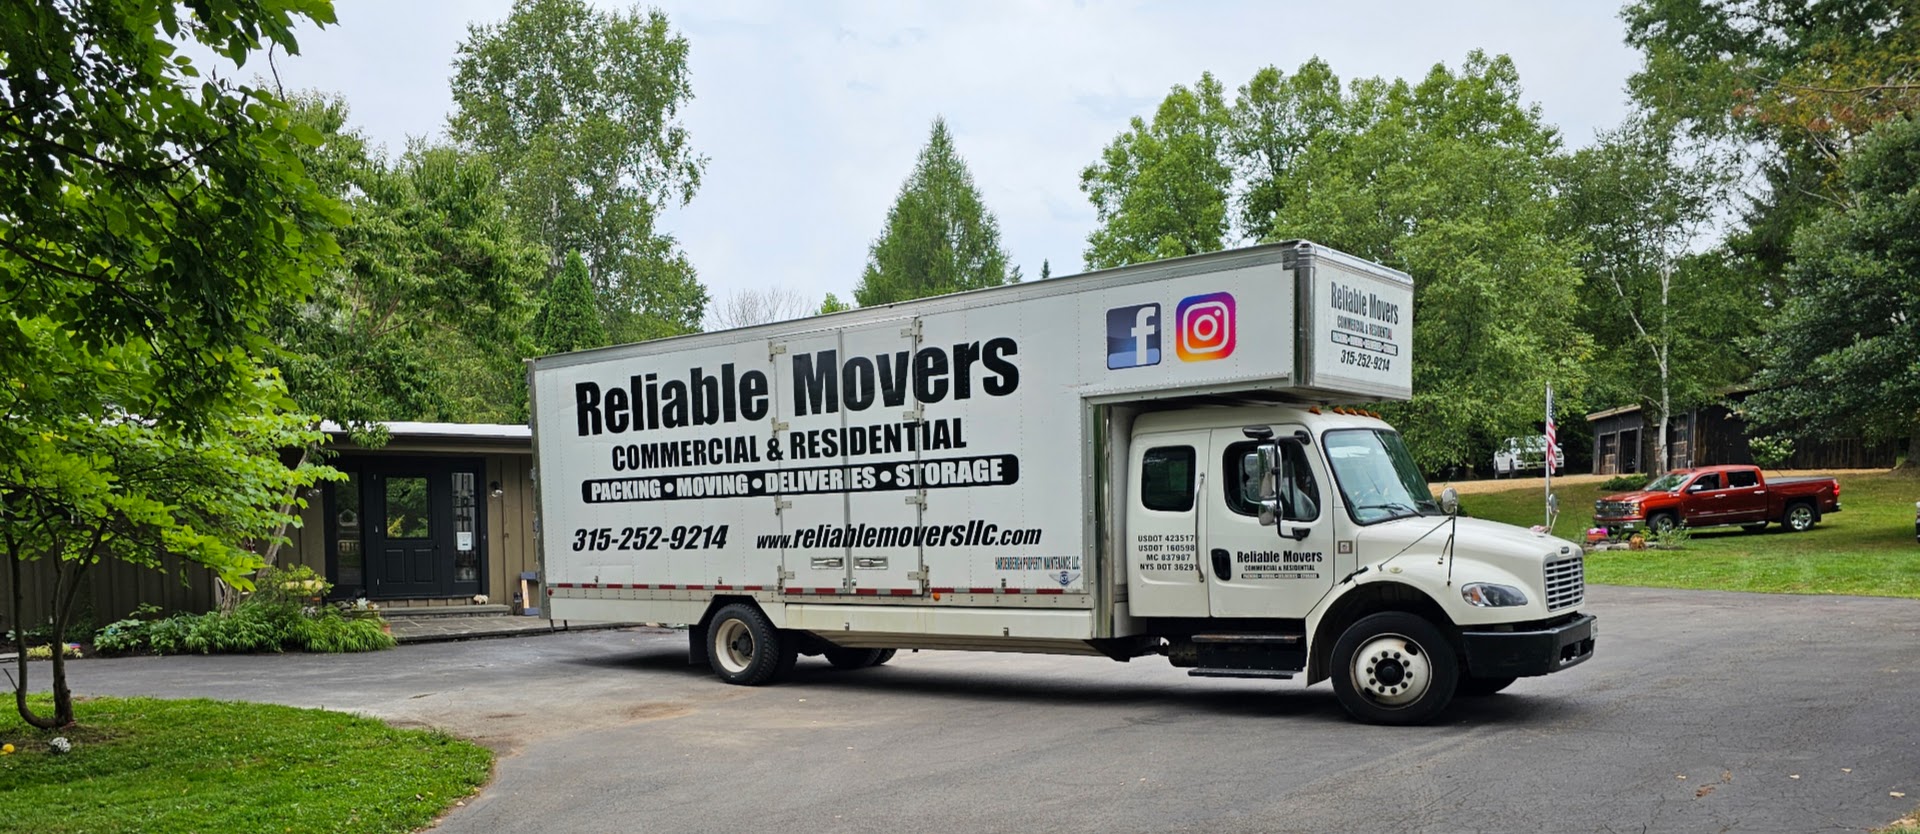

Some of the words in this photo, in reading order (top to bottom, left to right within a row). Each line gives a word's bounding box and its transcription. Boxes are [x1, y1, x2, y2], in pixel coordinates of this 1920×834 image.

[1331, 281, 1367, 317] Reliable
[1369, 293, 1399, 325] Movers
[1337, 315, 1365, 334] COMMERCIAL
[1369, 323, 1393, 341] RESIDENTIAL
[1340, 349, 1390, 372] 315-252-9214
[575, 362, 769, 437] Reliable
[792, 337, 1019, 417] Movers
[612, 435, 761, 471] COMMERCIAL
[766, 437, 784, 462] &
[790, 418, 967, 460] RESIDENTIAL
[591, 479, 662, 501] PACKING
[676, 473, 749, 497] MOVING
[764, 466, 877, 494] DELIVERIES
[895, 458, 1004, 487] STORAGE
[572, 524, 729, 551] 315-252-9214
[756, 520, 1042, 549] www.reliablemoversllc.com
[1137, 534, 1163, 542] USDOT
[1165, 534, 1195, 542] 423517
[1138, 544, 1163, 552] USDOT
[1166, 544, 1195, 552] 160598
[1146, 553, 1159, 561] MC
[1237, 550, 1280, 563] Reliable
[1283, 550, 1323, 563] Movers
